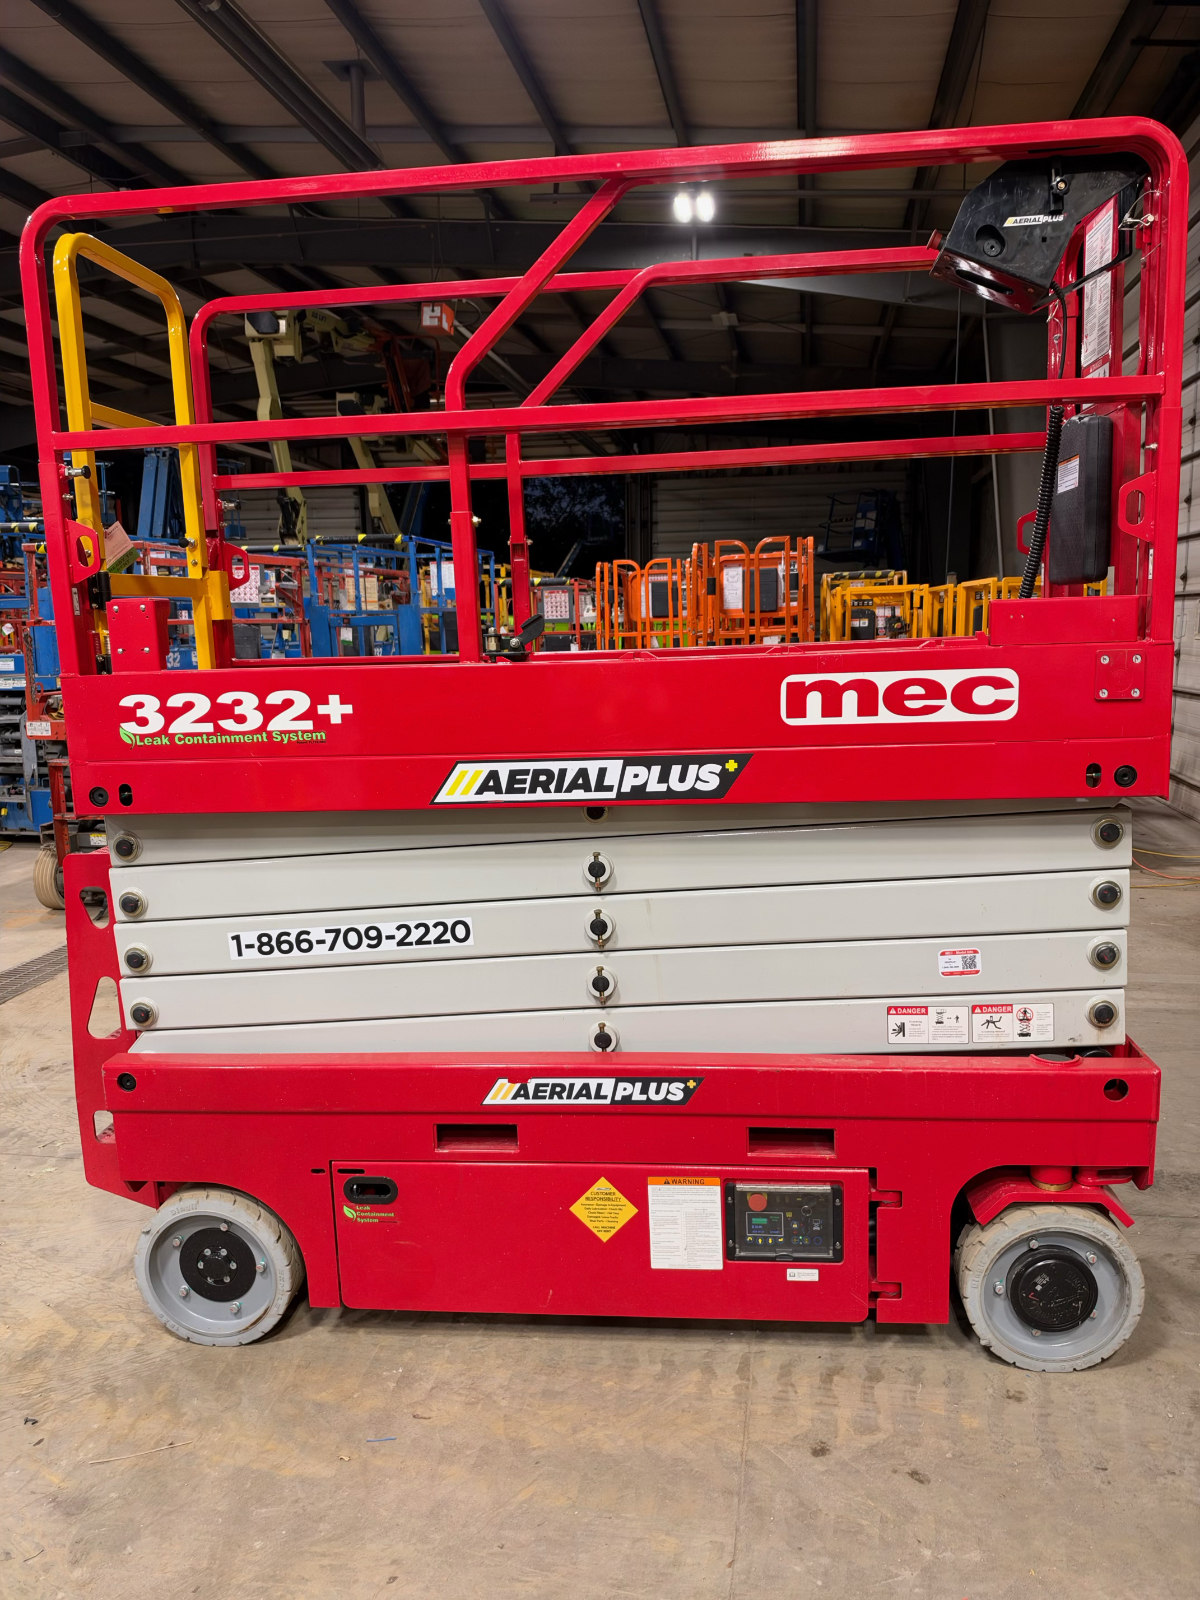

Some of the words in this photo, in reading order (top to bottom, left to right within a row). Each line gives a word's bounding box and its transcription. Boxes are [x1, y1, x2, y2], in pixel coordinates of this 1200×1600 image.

[786, 675, 1016, 719] mec
[118, 689, 354, 735] 3232+
[136, 734, 171, 747] Leak
[174, 730, 268, 746] Containment
[272, 730, 327, 744] System
[474, 766, 617, 796] AERIAL
[230, 919, 471, 957] 1-866-709-2220
[897, 1007, 926, 1015] DANGER
[982, 1005, 1013, 1013] DANGER
[510, 1082, 609, 1101] AERIAL
